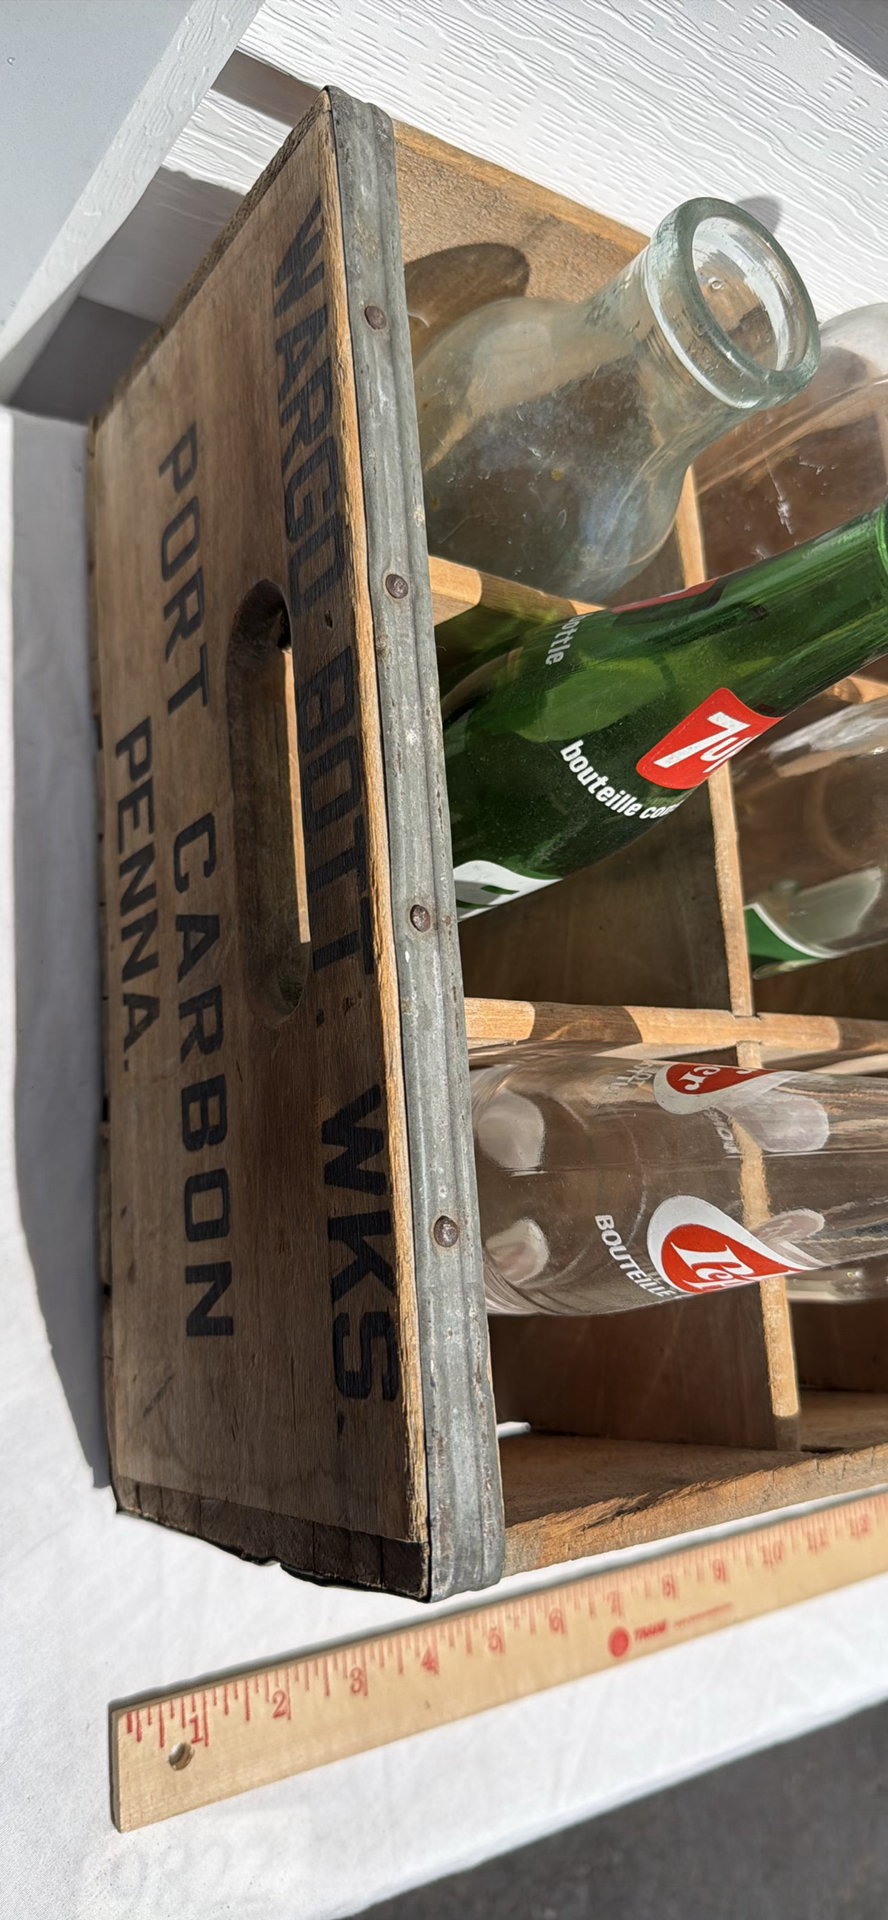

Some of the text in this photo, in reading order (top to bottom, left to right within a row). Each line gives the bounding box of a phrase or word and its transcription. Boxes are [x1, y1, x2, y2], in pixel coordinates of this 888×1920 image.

[273, 196, 347, 617] WARGO
[115, 715, 161, 1073] PENNA.
[158, 420, 235, 1337] PORT CARBON
[560, 739, 643, 817] bouteille
[595, 1214, 677, 1298] BOUTEILLE
[190, 1714, 204, 1744] 1
[272, 1690, 288, 1719] 2
[350, 1667, 364, 1695] 3
[422, 1650, 438, 1673] 4
[488, 1627, 503, 1653] 5
[549, 1607, 564, 1633] 6
